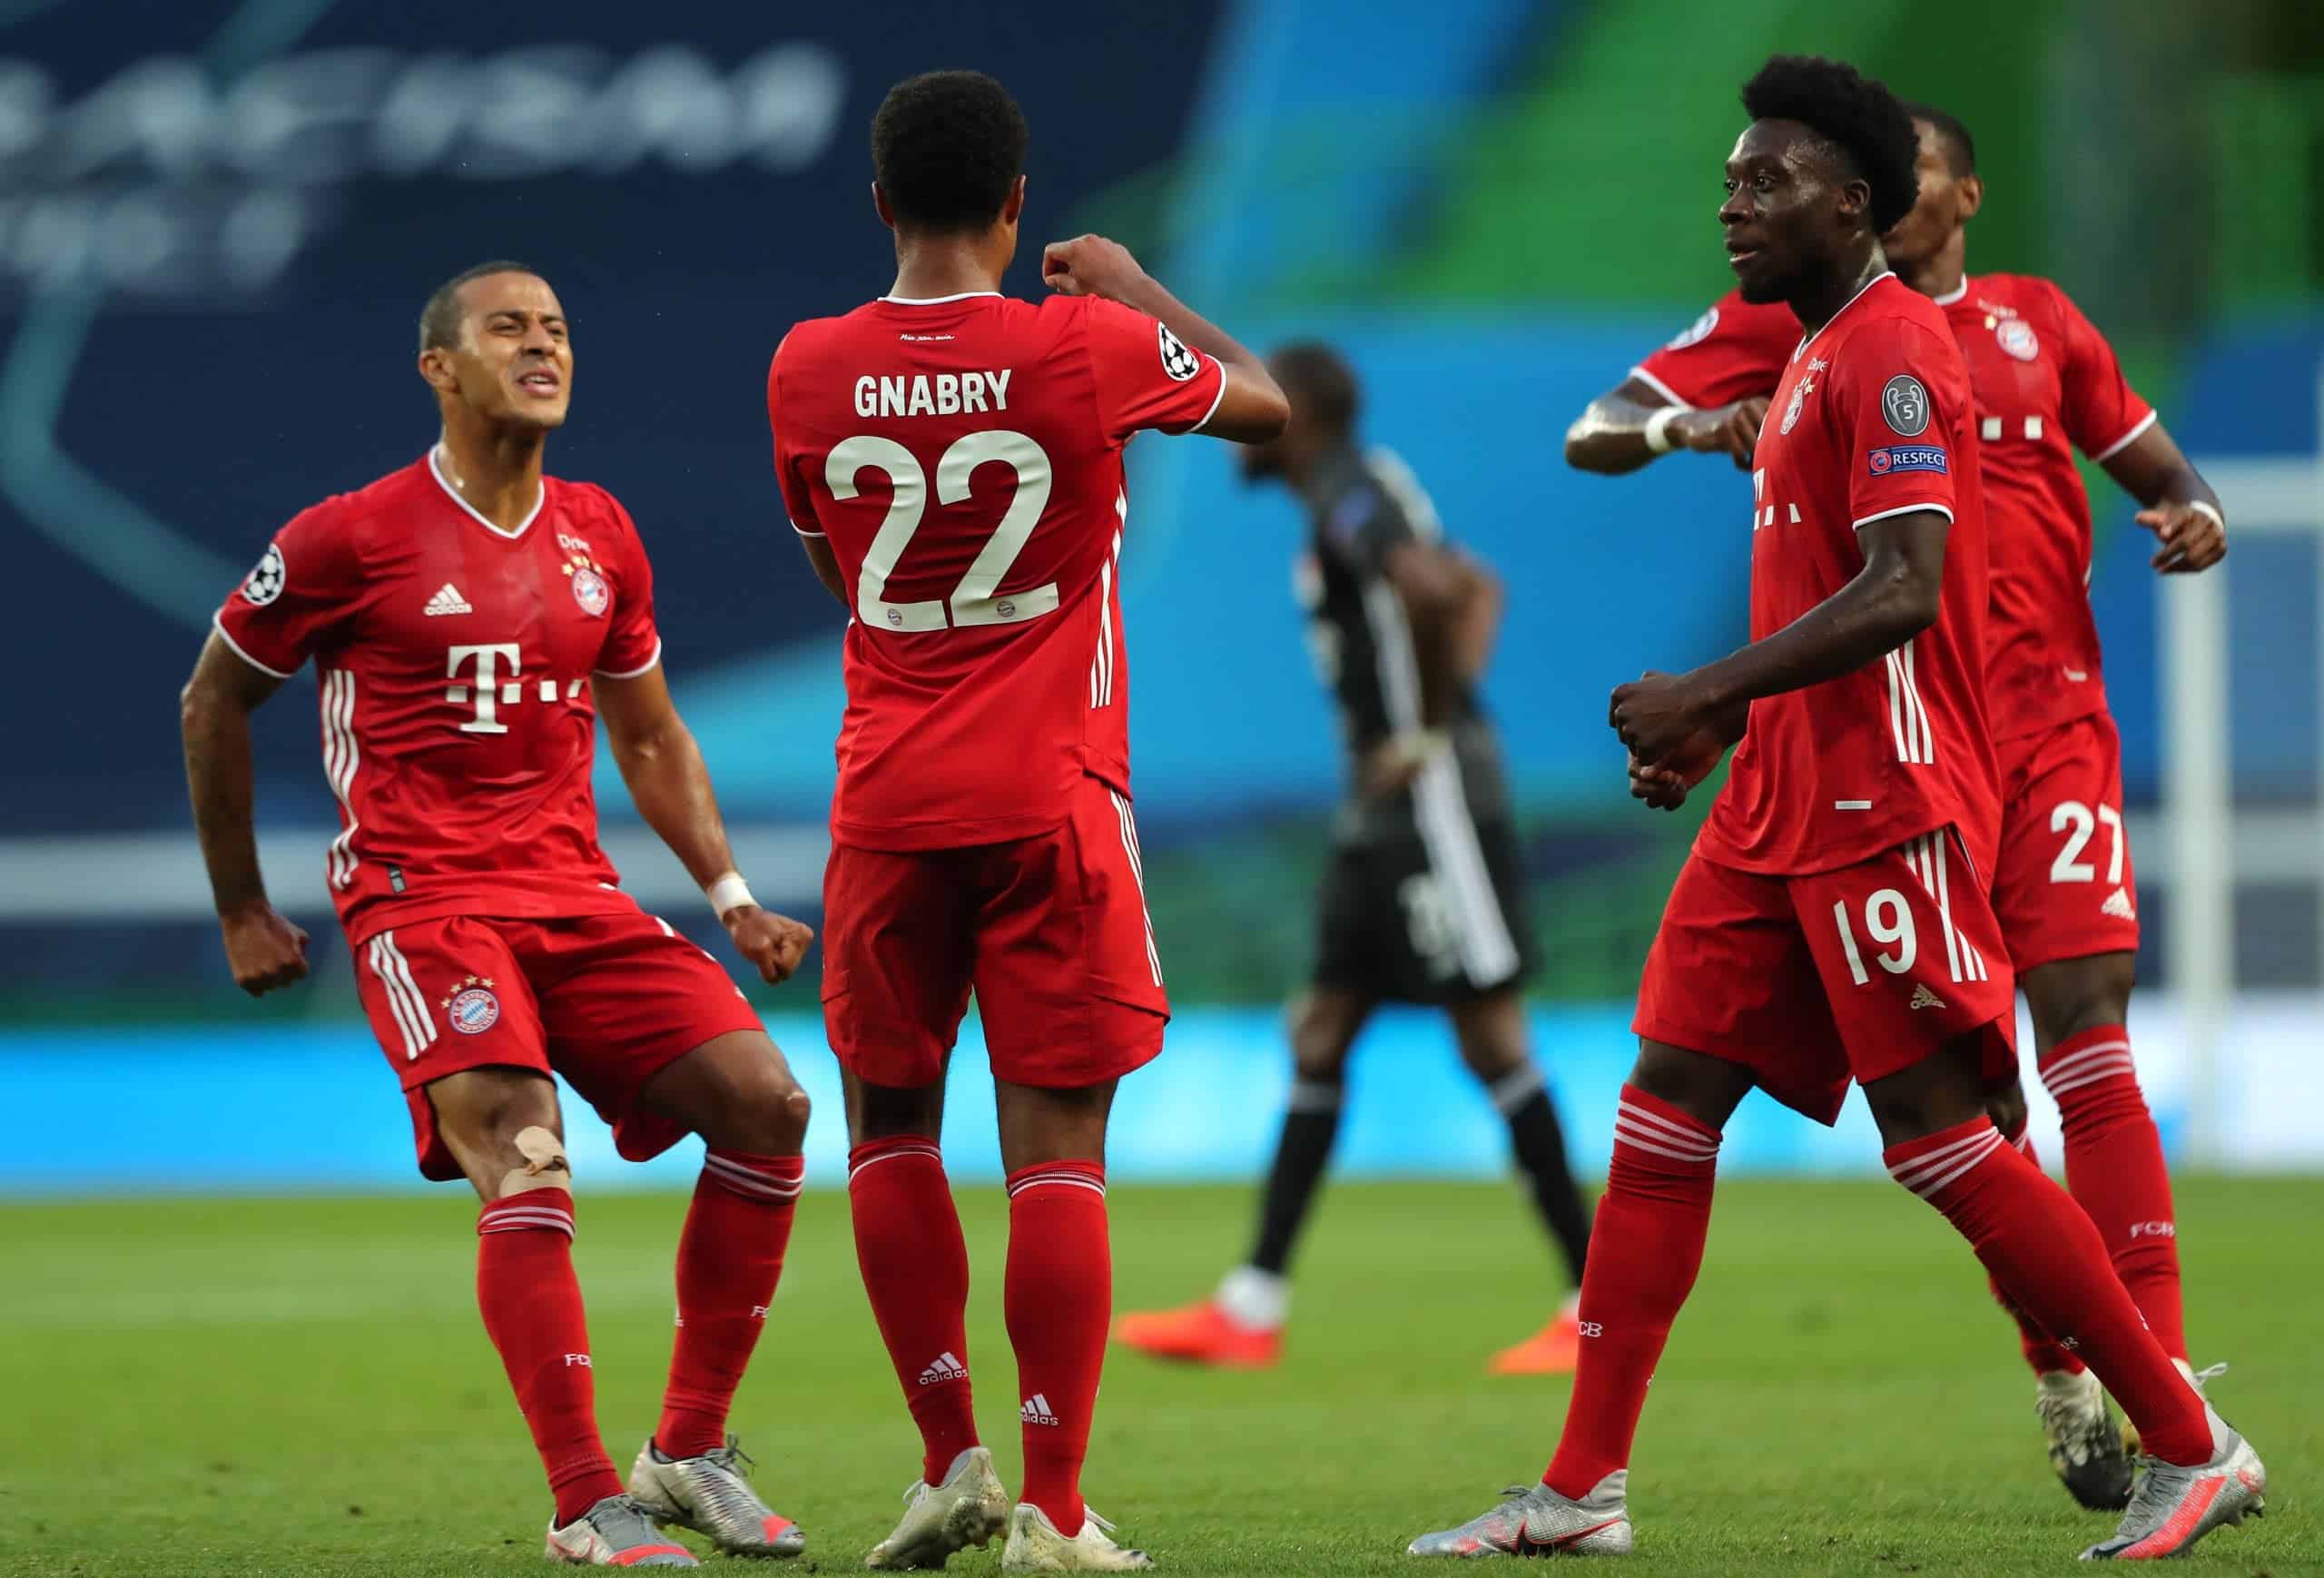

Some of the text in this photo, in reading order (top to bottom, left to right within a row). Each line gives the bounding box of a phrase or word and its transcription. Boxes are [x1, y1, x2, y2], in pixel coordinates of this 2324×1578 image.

[854, 369, 1011, 418] GNABRY
[1904, 404, 1914, 419] 5
[1893, 452, 1946, 467] RESPECT
[825, 429, 1059, 632] 22
[447, 643, 521, 734] T
[2050, 801, 2124, 884] 27
[1834, 889, 1917, 985] 19
[1578, 1321, 1603, 1337] CB
[565, 1353, 592, 1367] FC
[919, 1368, 969, 1386] adidas
[1019, 1412, 1059, 1426] didas
